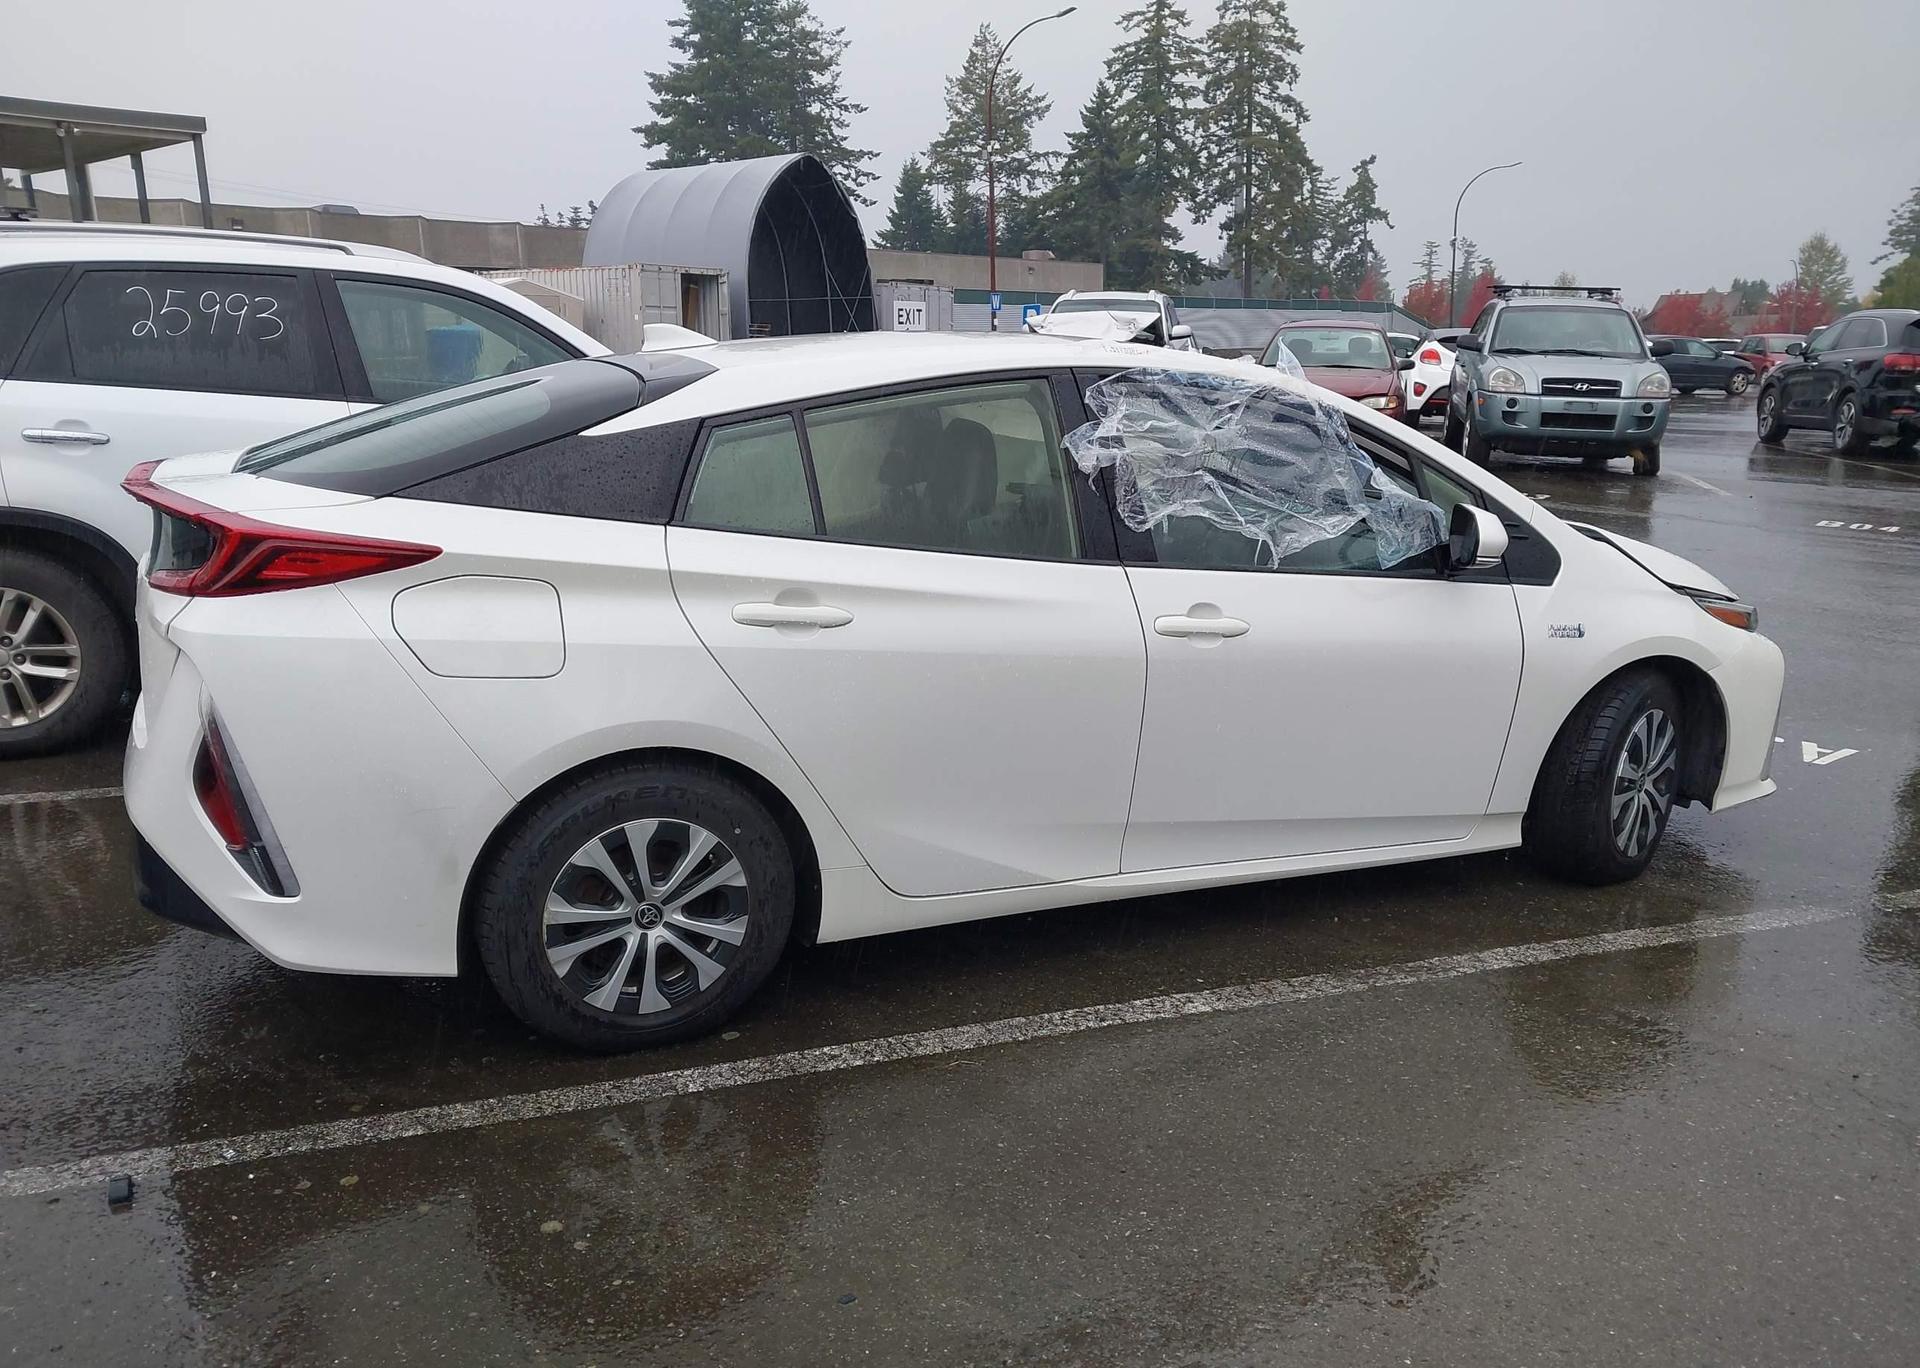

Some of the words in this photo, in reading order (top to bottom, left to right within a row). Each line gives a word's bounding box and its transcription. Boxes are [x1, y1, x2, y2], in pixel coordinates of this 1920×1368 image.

[991, 294, 1001, 310] W
[126, 286, 284, 340] 25993
[897, 307, 923, 326] EXIT
